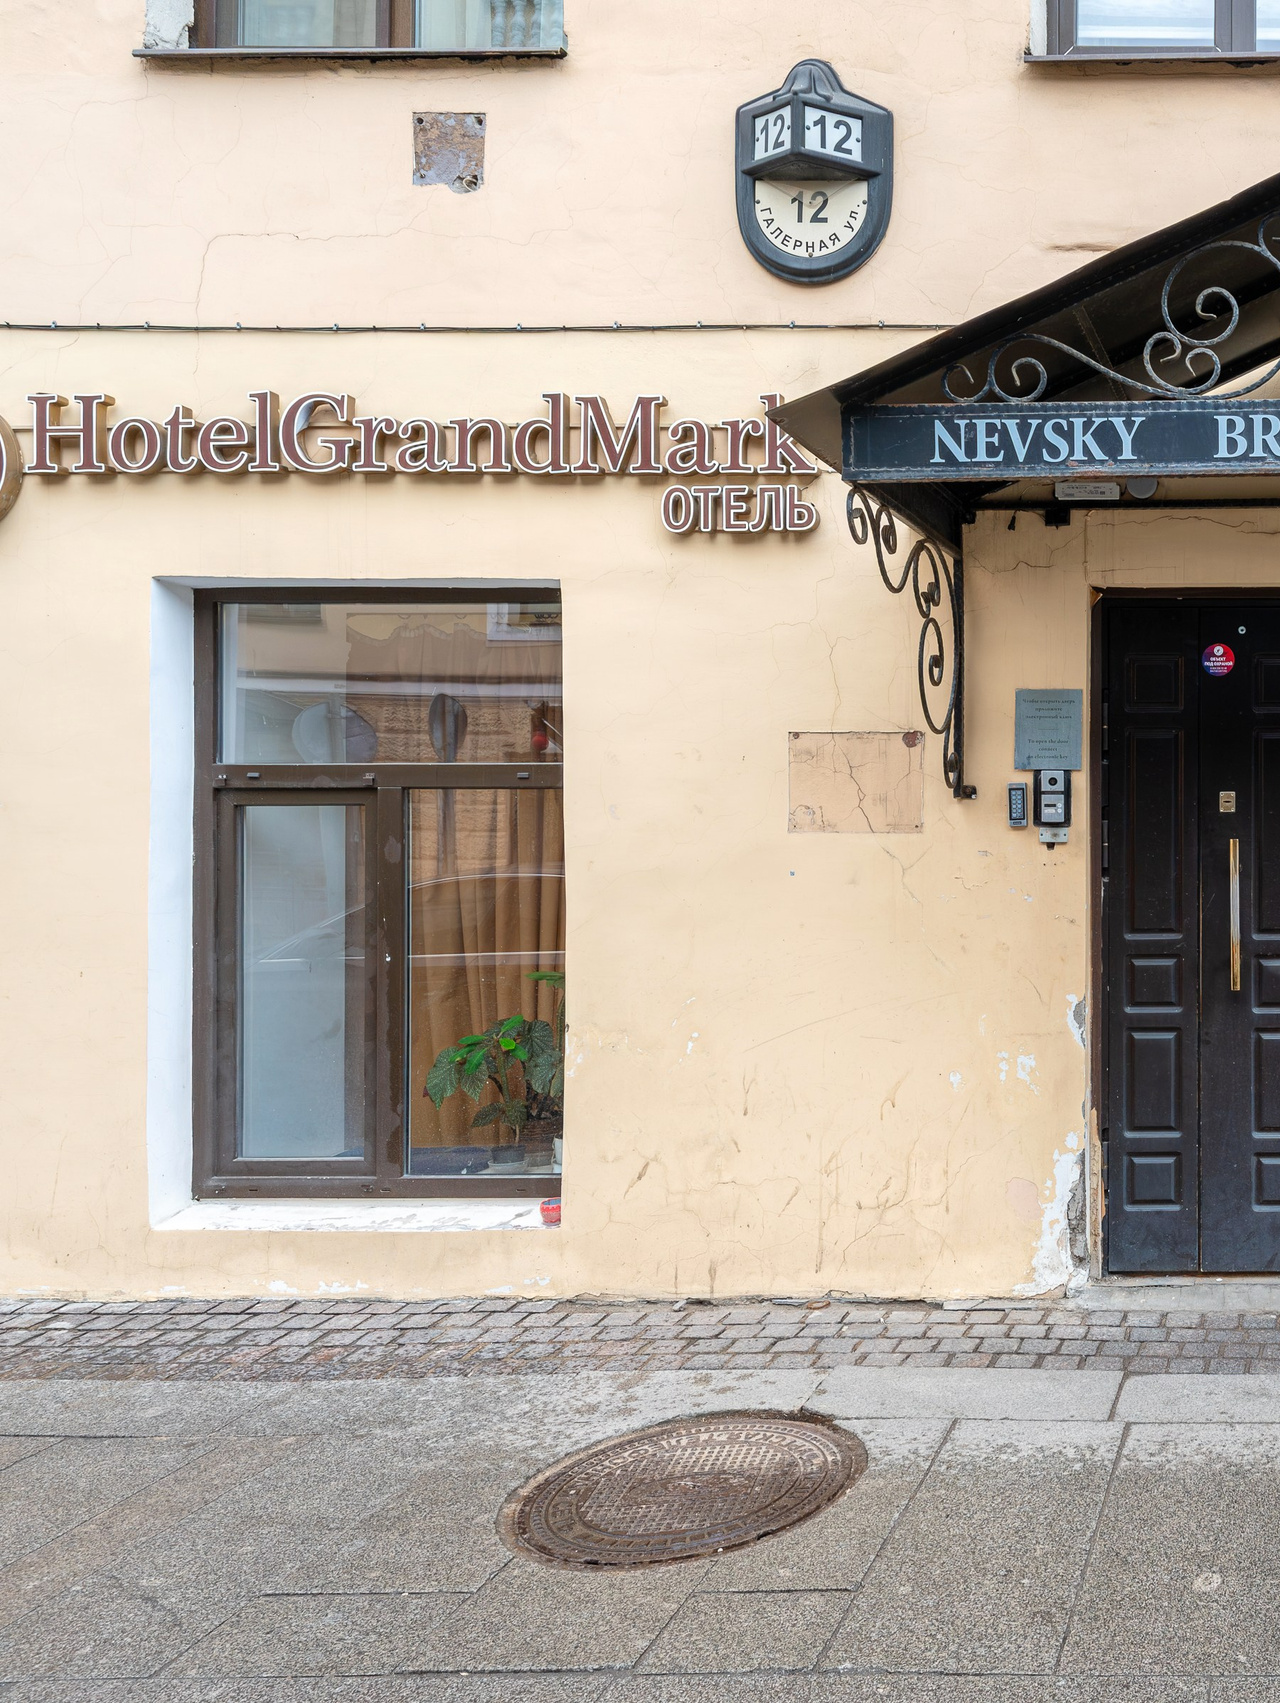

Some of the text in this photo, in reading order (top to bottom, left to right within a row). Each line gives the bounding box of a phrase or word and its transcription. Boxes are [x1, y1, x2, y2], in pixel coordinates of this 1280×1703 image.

[760, 113, 785, 153] 12
[813, 115, 853, 155] 12
[791, 190, 829, 223] 12
[760, 207, 841, 253] ГАЛЕРНАЯ
[929, 416, 1146, 463] NEVSKY
[660, 484, 817, 533] ОТЕЛЬ
